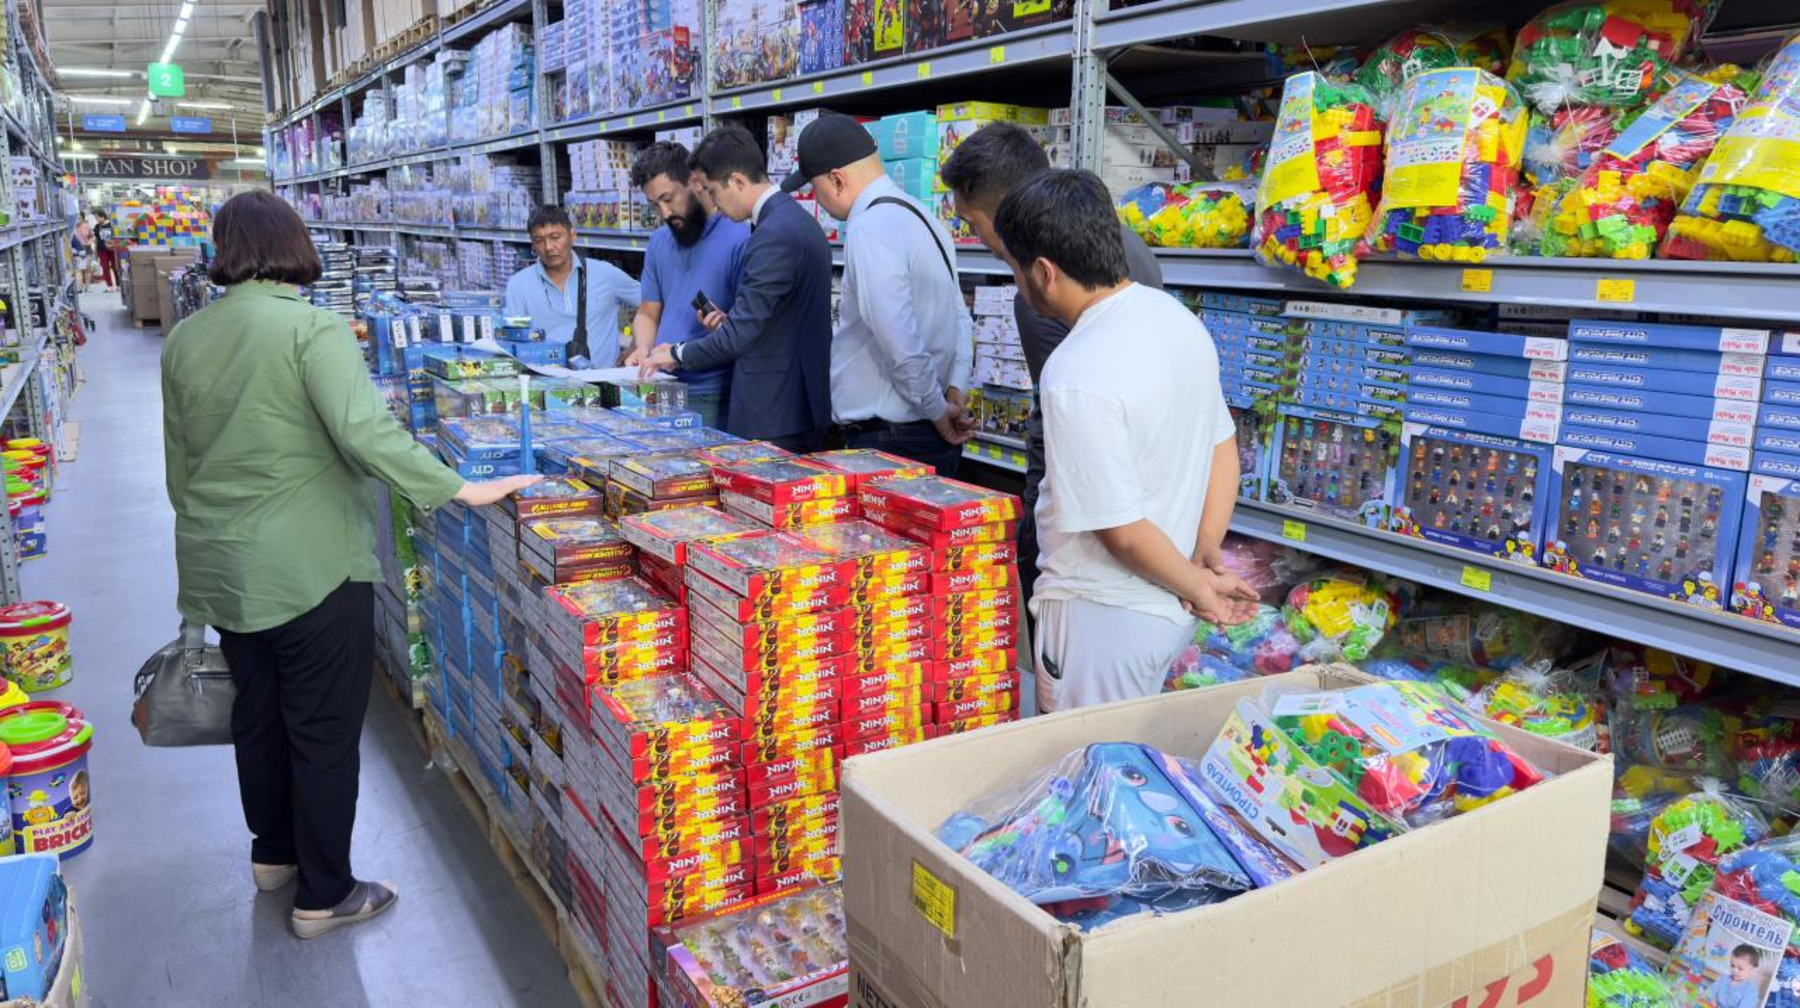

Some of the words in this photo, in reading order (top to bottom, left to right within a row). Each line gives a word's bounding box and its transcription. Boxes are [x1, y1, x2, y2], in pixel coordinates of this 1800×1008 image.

[161, 74, 172, 88] 2
[141, 160, 197, 176] SHOP
[675, 417, 693, 427] CITY
[470, 465, 494, 475] CITY
[1207, 762, 1259, 819] СТРОИТЕЛЬ
[1713, 904, 1783, 946] Строитель
